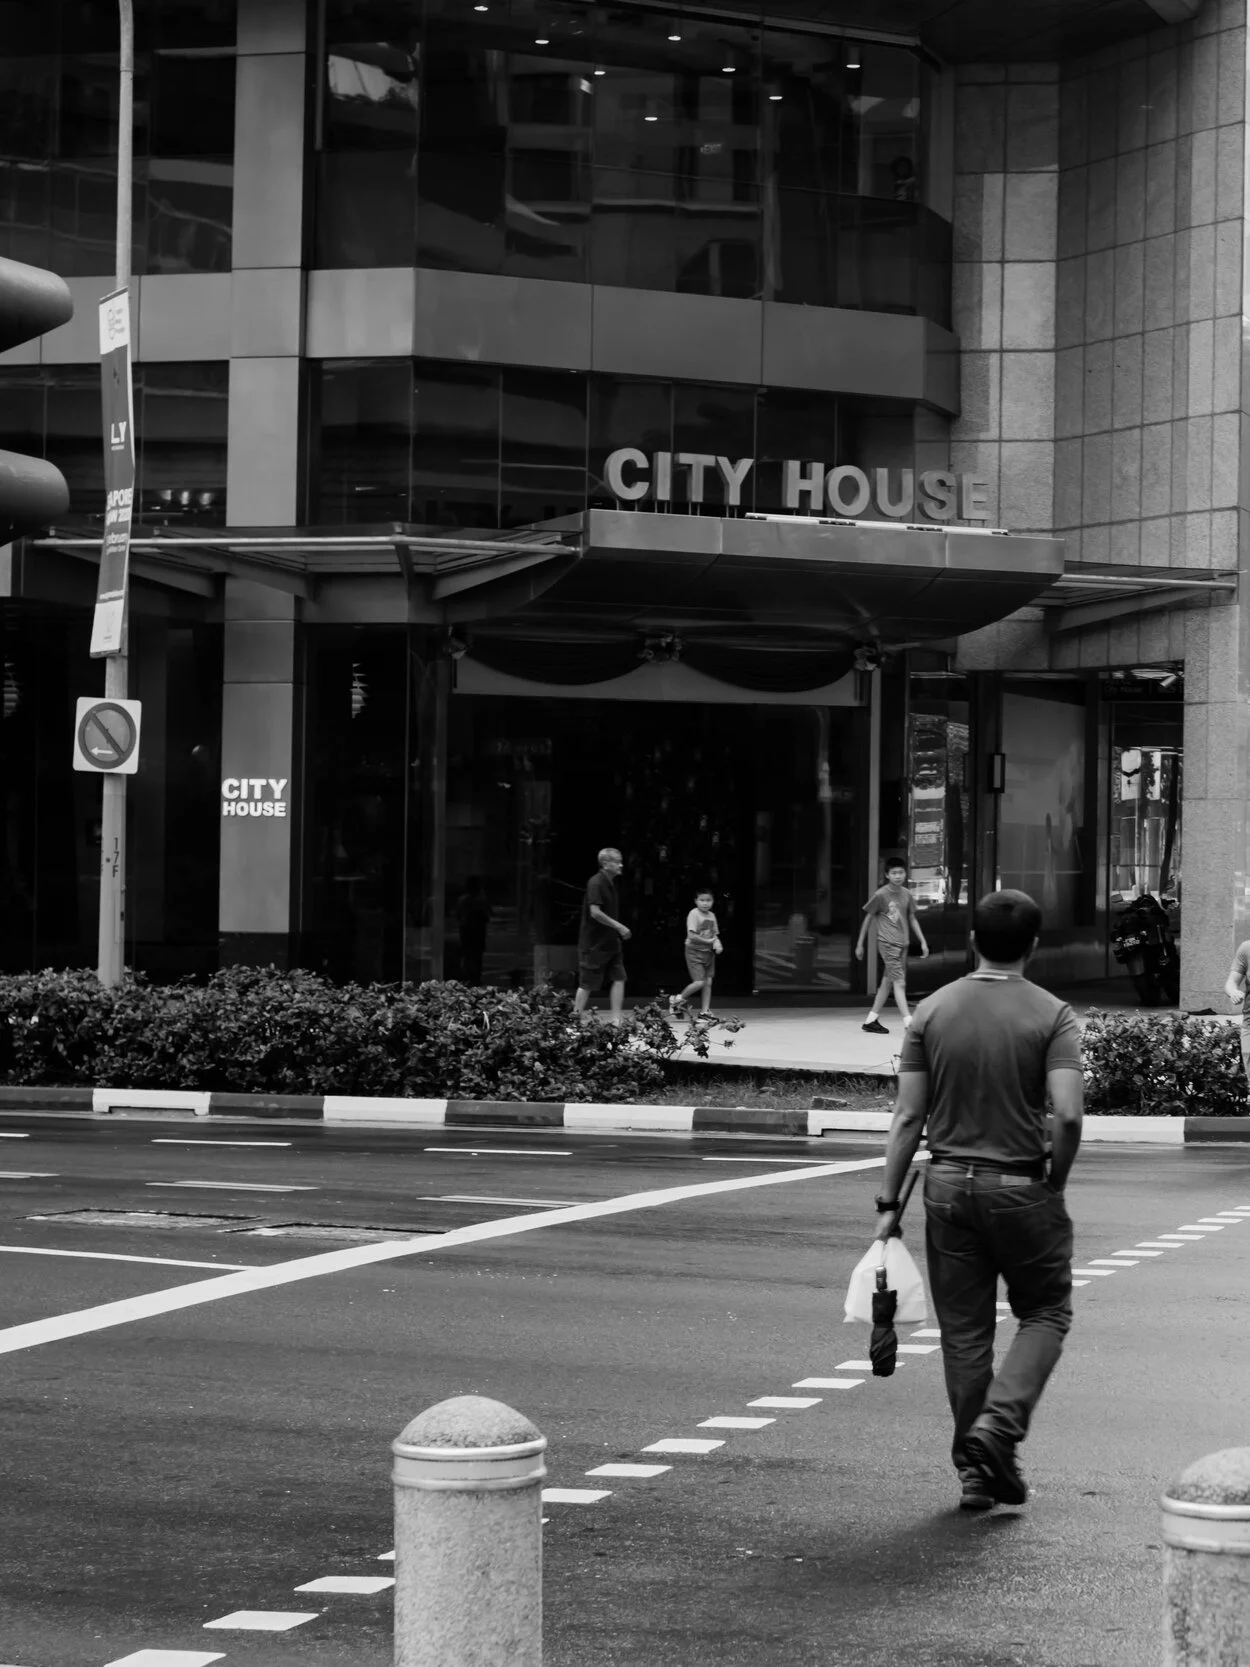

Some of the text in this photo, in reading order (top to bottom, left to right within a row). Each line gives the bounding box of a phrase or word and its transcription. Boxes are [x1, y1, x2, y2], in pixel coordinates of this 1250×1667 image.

[604, 447, 992, 521] CITY HOUSE
[221, 778, 288, 799] CITY
[222, 801, 287, 817] HOUSE
